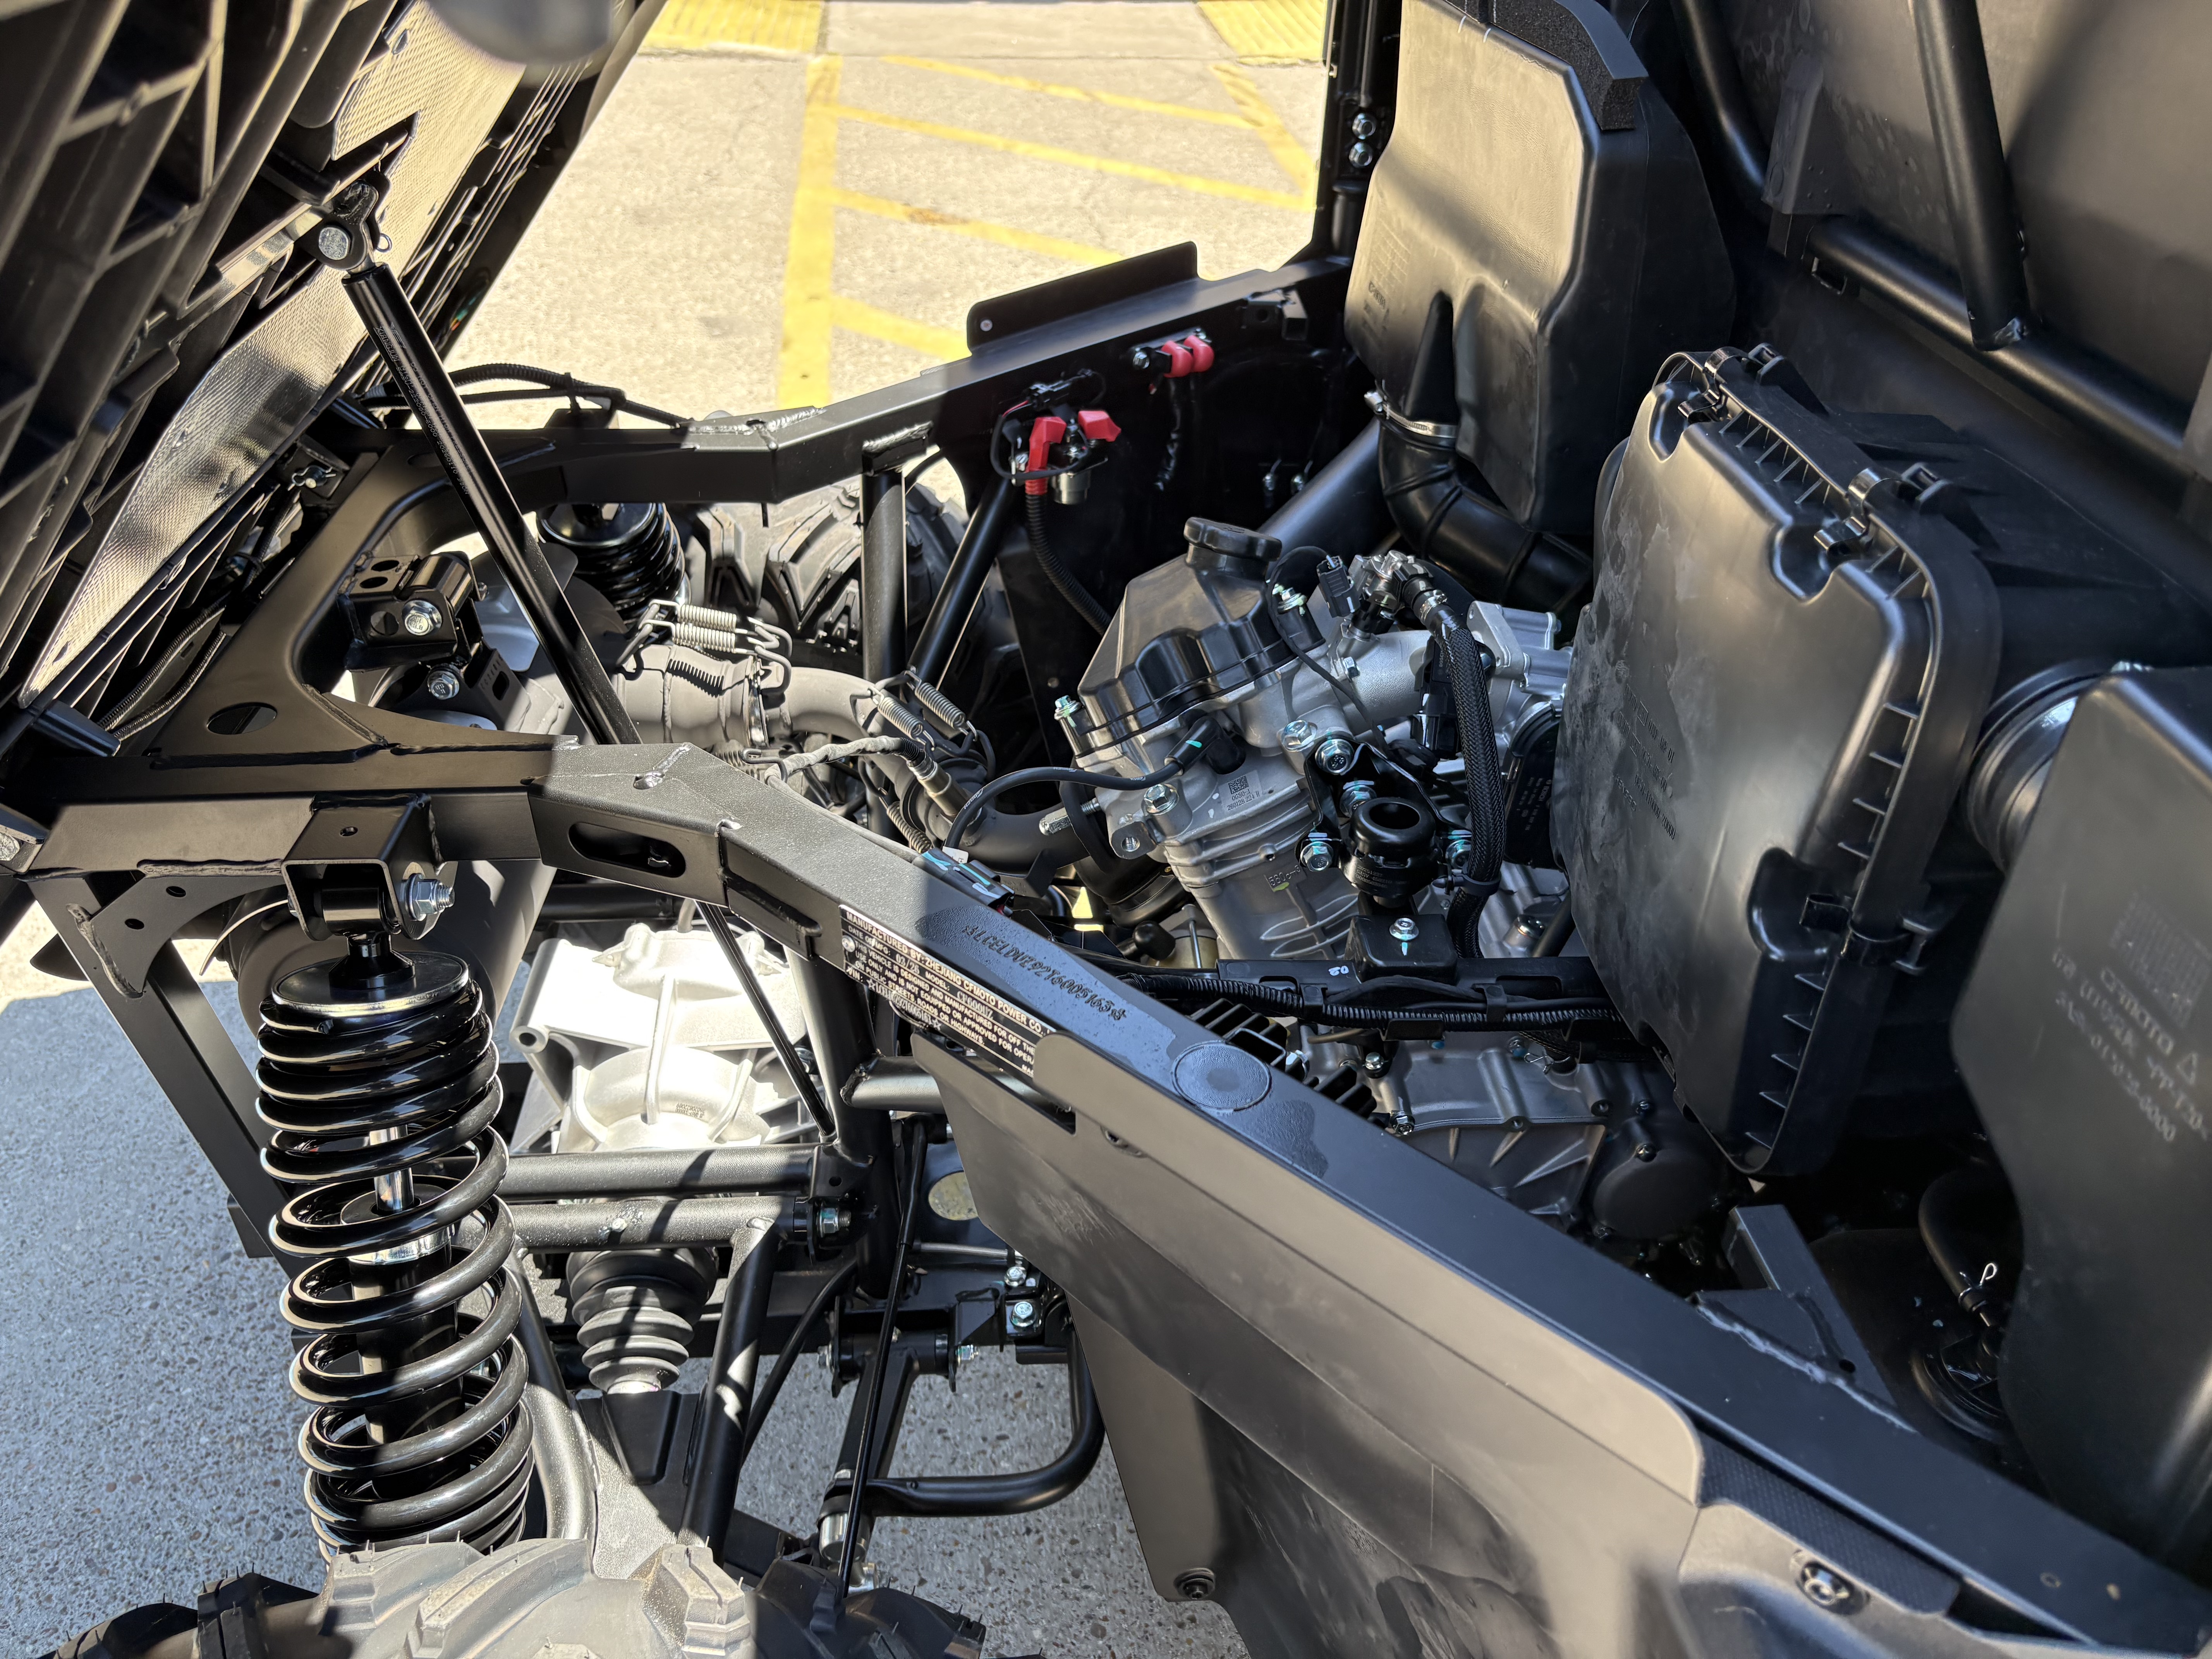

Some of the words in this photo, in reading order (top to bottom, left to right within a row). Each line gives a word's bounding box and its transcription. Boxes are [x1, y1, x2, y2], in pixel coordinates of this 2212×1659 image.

[1538, 785, 1549, 801] BOSCH
[846, 911, 907, 954] MANUFACTURED
[926, 958, 962, 986] ZHEJIANG
[963, 980, 996, 1006] CFMOTO
[998, 1000, 1027, 1025] POWER
[848, 925, 863, 939] DATE
[925, 971, 949, 991] MODEL:
[855, 941, 867, 954] THIS
[869, 950, 891, 969] VEHICLE
[898, 967, 929, 991] DESIGNED
[932, 988, 943, 1000] AND
[945, 995, 992, 1030] MANUFACTURED
[994, 1025, 1006, 1039] FOR
[1008, 1034, 1019, 1047] OFF
[855, 950, 867, 963] USE
[868, 959, 882, 973] ONLY
[885, 969, 896, 981] AND
[906, 982, 918, 994] NOT
[920, 990, 950, 1014] EQUIPPED
[964, 1017, 996, 1043] APPROVED
[999, 1038, 1012, 1053] FOR
[866, 967, 886, 984] PUBLIC
[917, 998, 938, 1016] ROADS
[951, 1018, 984, 1045] HIGHWAYS.
